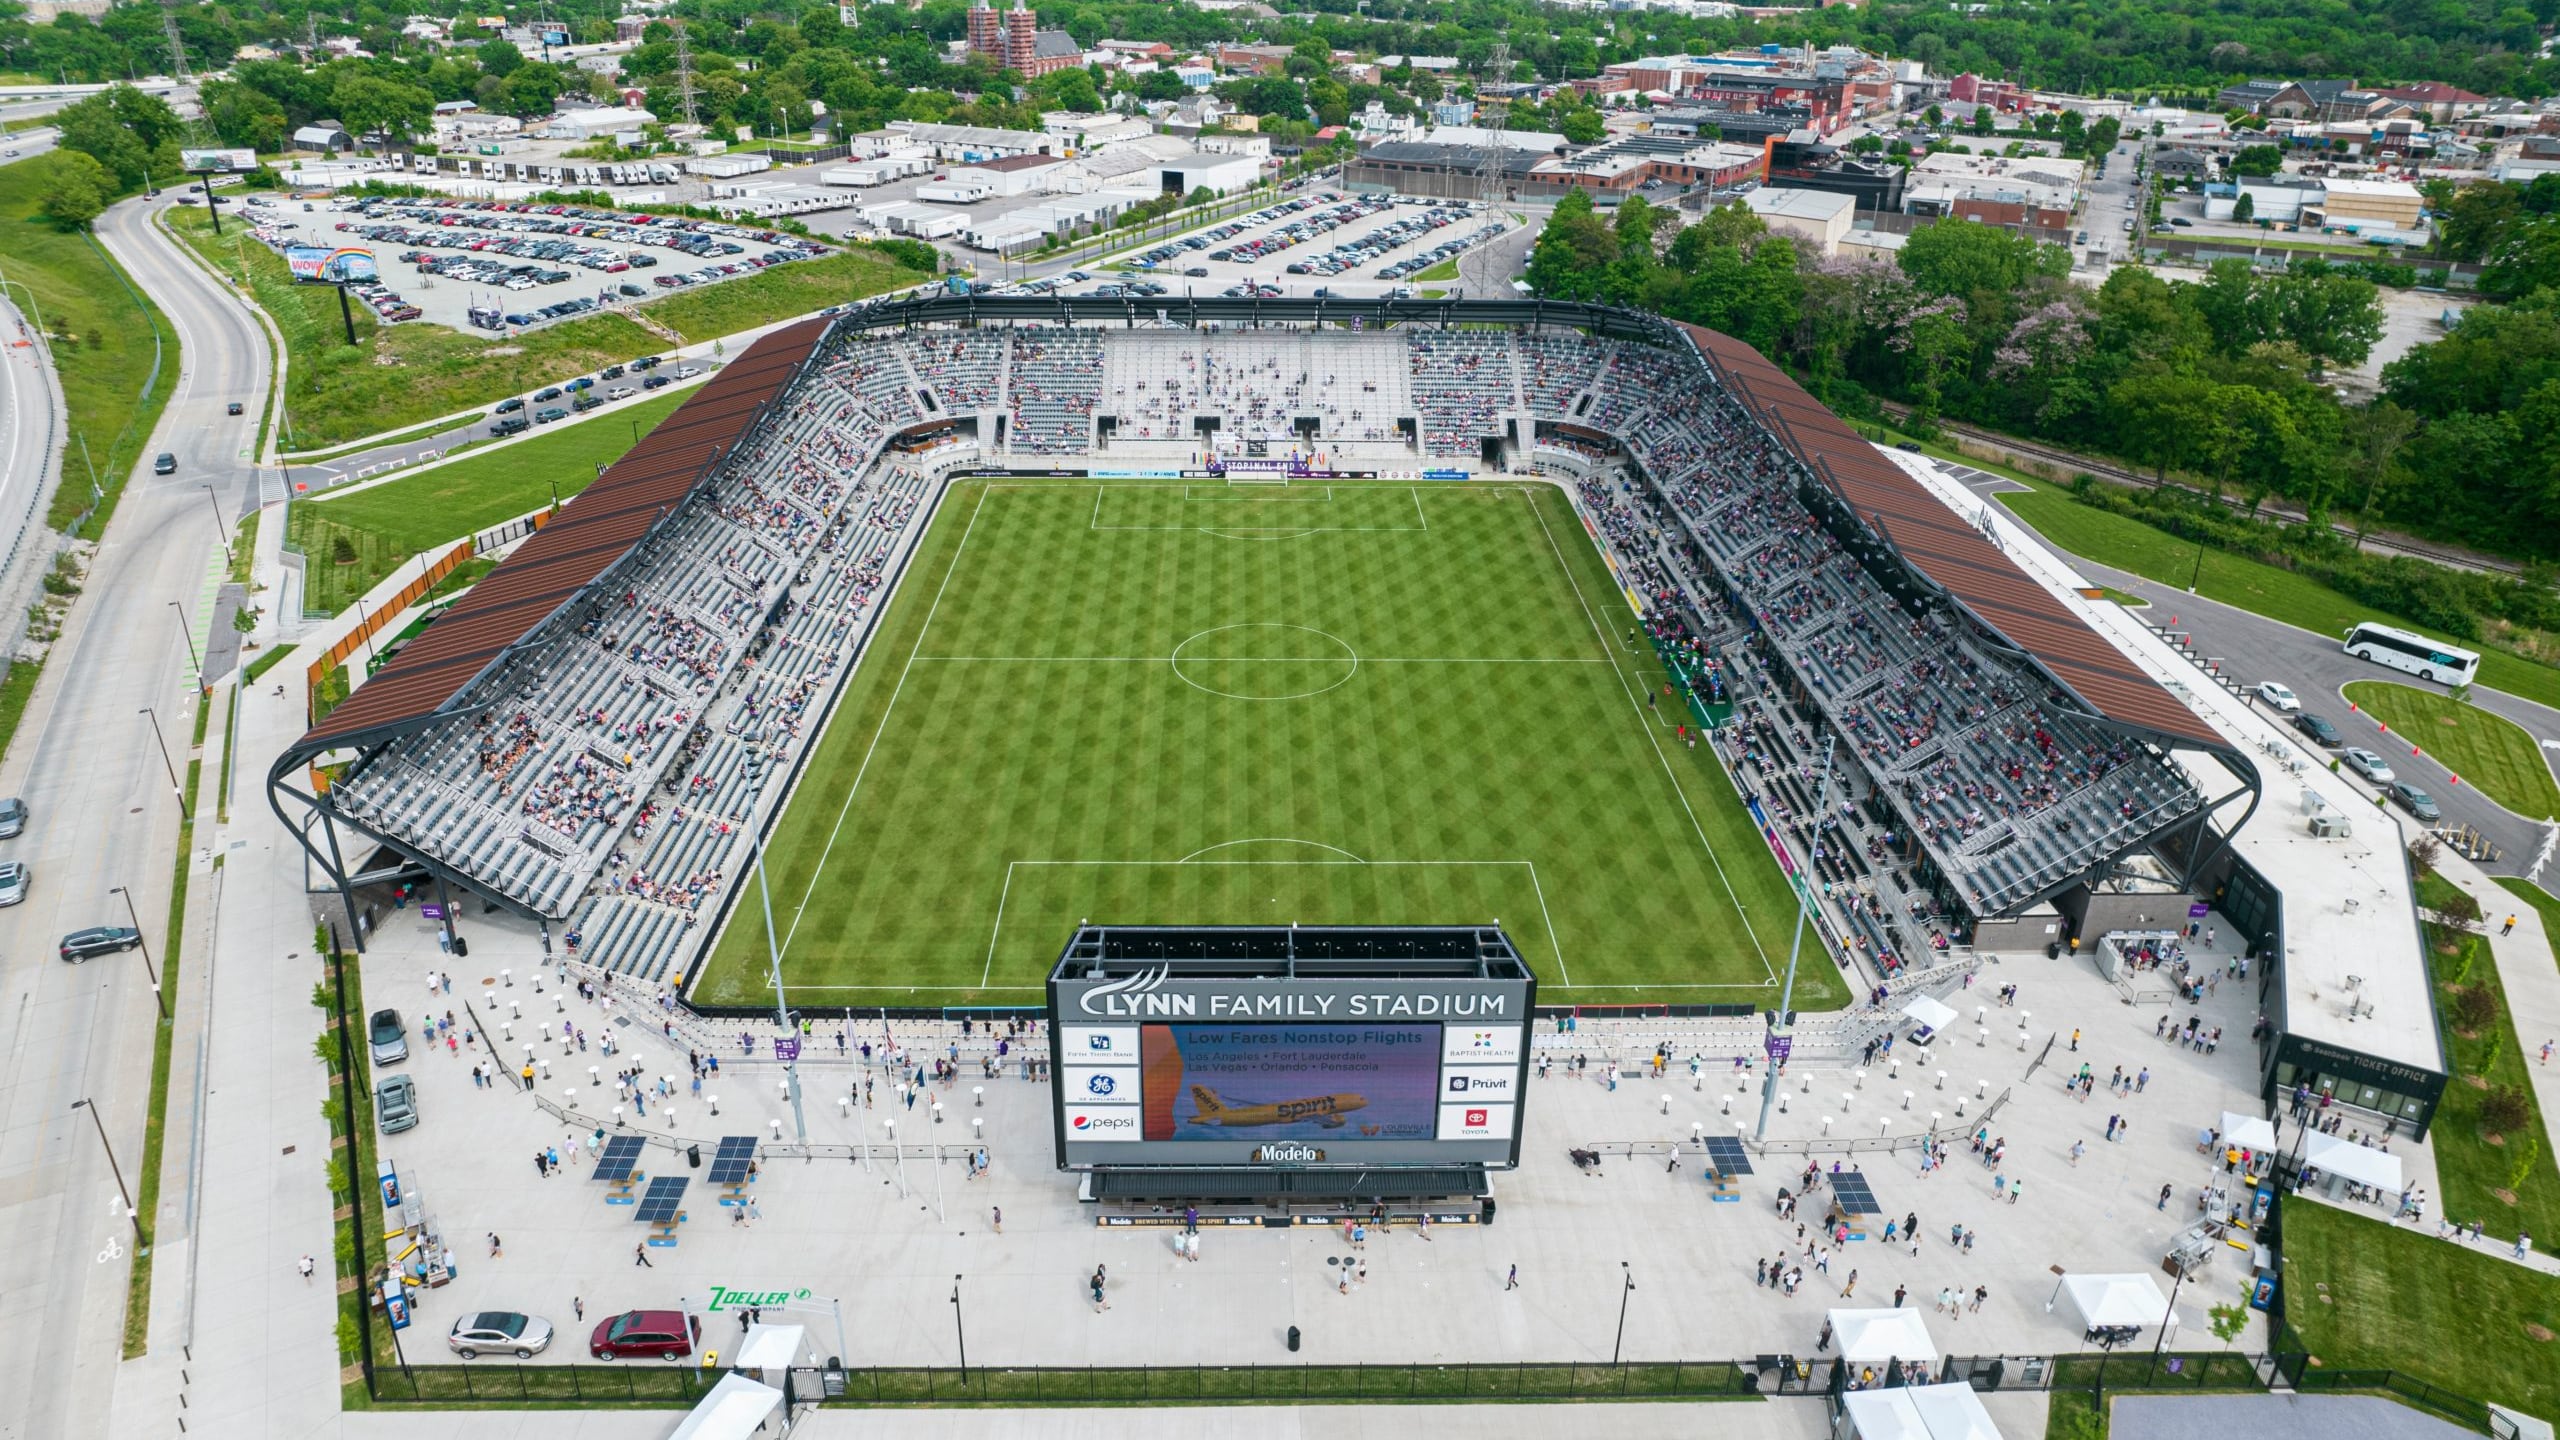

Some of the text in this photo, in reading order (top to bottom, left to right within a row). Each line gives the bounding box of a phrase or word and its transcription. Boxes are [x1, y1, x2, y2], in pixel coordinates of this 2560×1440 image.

[1220, 461, 1295, 471] ESTOPINAL END
[1106, 993, 1506, 1016] LYNN FAMILY STADIUM
[1188, 1030, 1423, 1046] Low Fares Nonstop Flights
[1188, 1050, 1367, 1063] Los Angeles Fort Lauderdale
[1188, 1061, 1379, 1073] Las Vegas Orlando Pensacola
[2353, 1056, 2389, 1072] TICKET
[2391, 1066, 2428, 1083] OFFICE
[1472, 1078, 1507, 1088] Prüvit
[1192, 1086, 1220, 1113] spirit
[1277, 1095, 1337, 1121] spirit
[1093, 1117, 1134, 1130] pepsi
[1261, 1145, 1317, 1161] Modelo
[1110, 1217, 1132, 1225] Modelo
[1229, 1216, 1250, 1225] Modelo
[1307, 1216, 1328, 1224] Modelo
[1441, 1215, 1462, 1223] Modelo
[708, 1286, 791, 1311] ZOELLER
